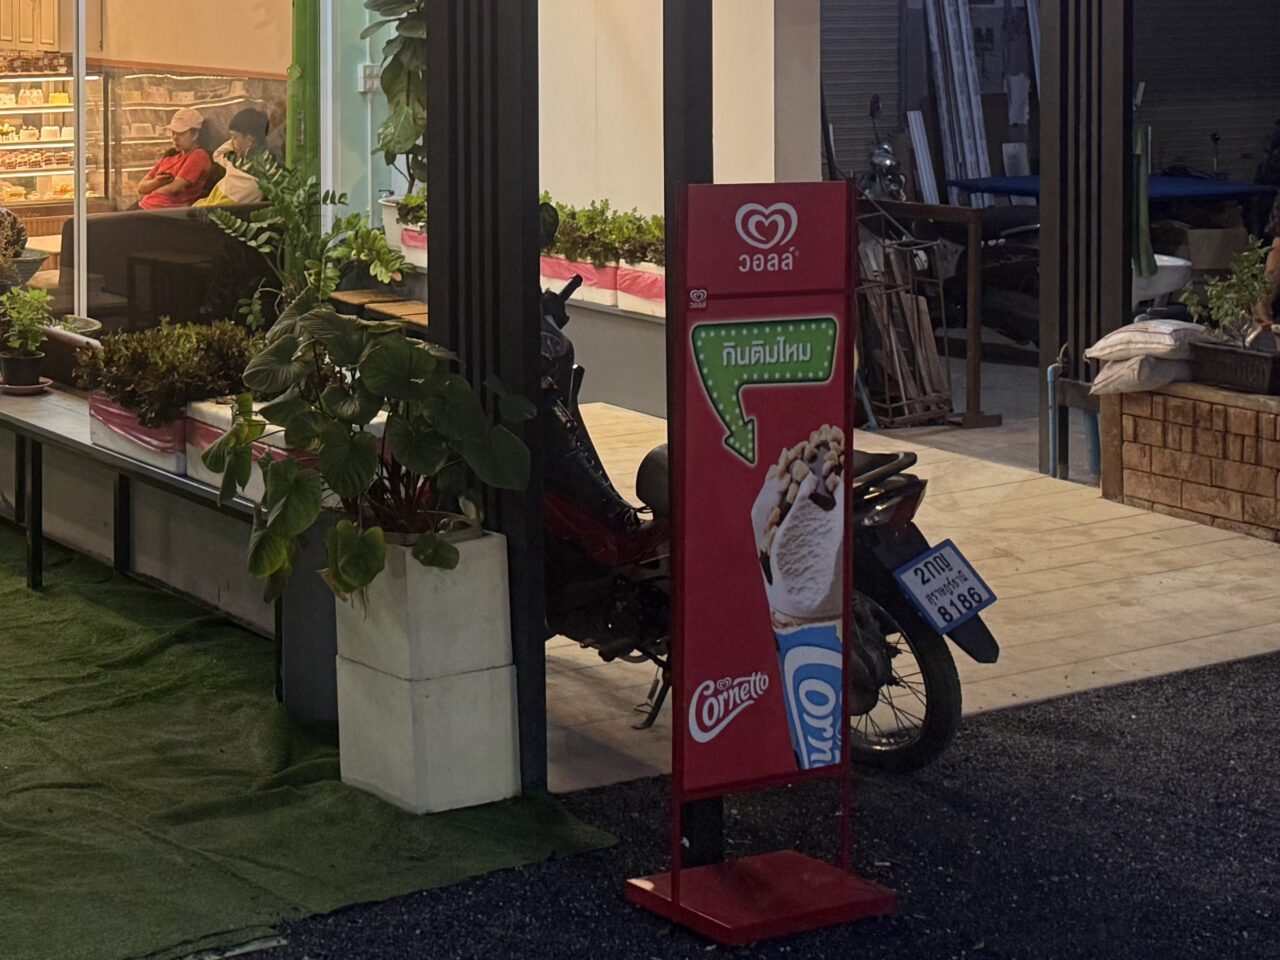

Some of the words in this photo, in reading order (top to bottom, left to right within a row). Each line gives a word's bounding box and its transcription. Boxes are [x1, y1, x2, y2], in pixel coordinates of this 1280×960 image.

[738, 247, 794, 272] วอลล์
[723, 336, 812, 366] กินติมไหม
[937, 587, 982, 623] 8186
[688, 671, 770, 744] Cornetto
